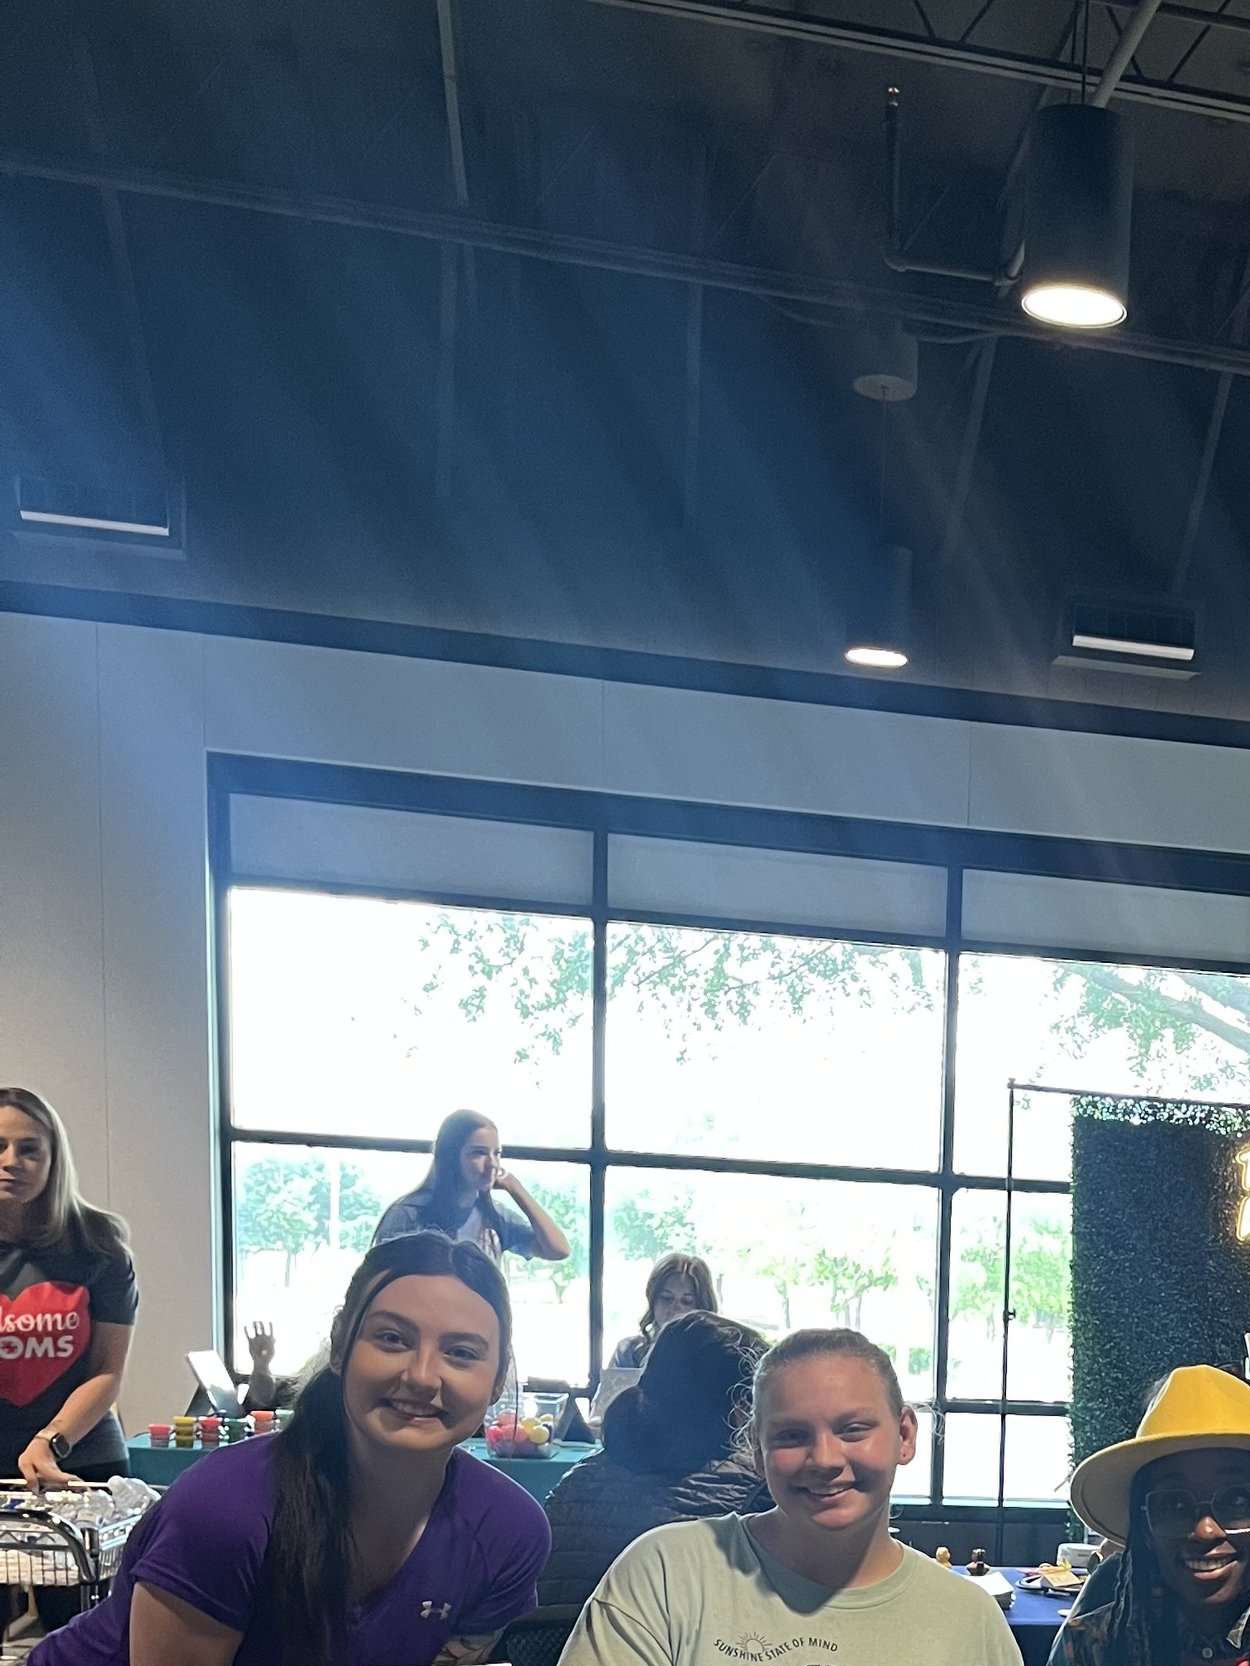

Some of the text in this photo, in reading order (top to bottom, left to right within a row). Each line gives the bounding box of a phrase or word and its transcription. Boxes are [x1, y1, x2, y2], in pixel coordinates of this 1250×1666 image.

[713, 1636, 839, 1662] SUNSHINE STATE OF MIND
